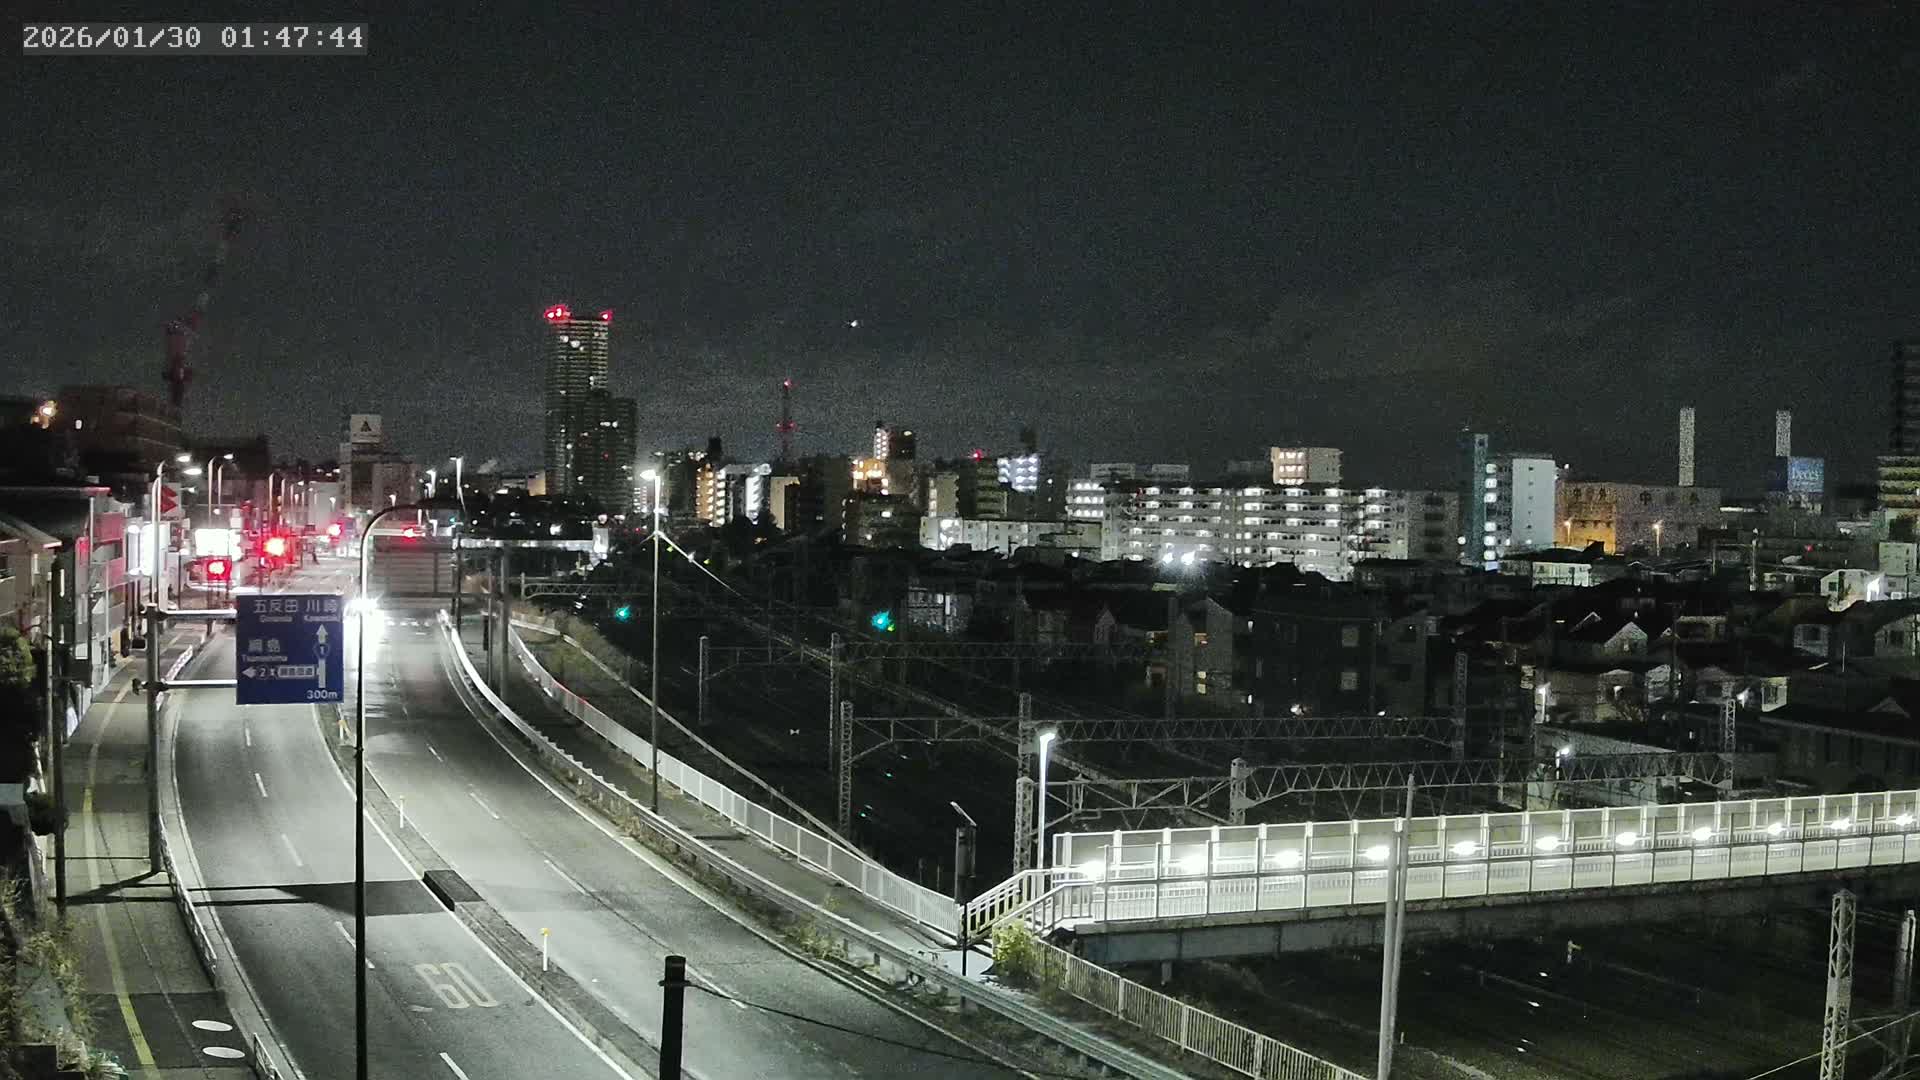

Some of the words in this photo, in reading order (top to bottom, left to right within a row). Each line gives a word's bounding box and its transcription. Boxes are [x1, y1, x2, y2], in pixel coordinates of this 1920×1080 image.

[253, 599, 297, 613] 五反田
[307, 689, 338, 699] 300m
[414, 962, 499, 1009] 60
